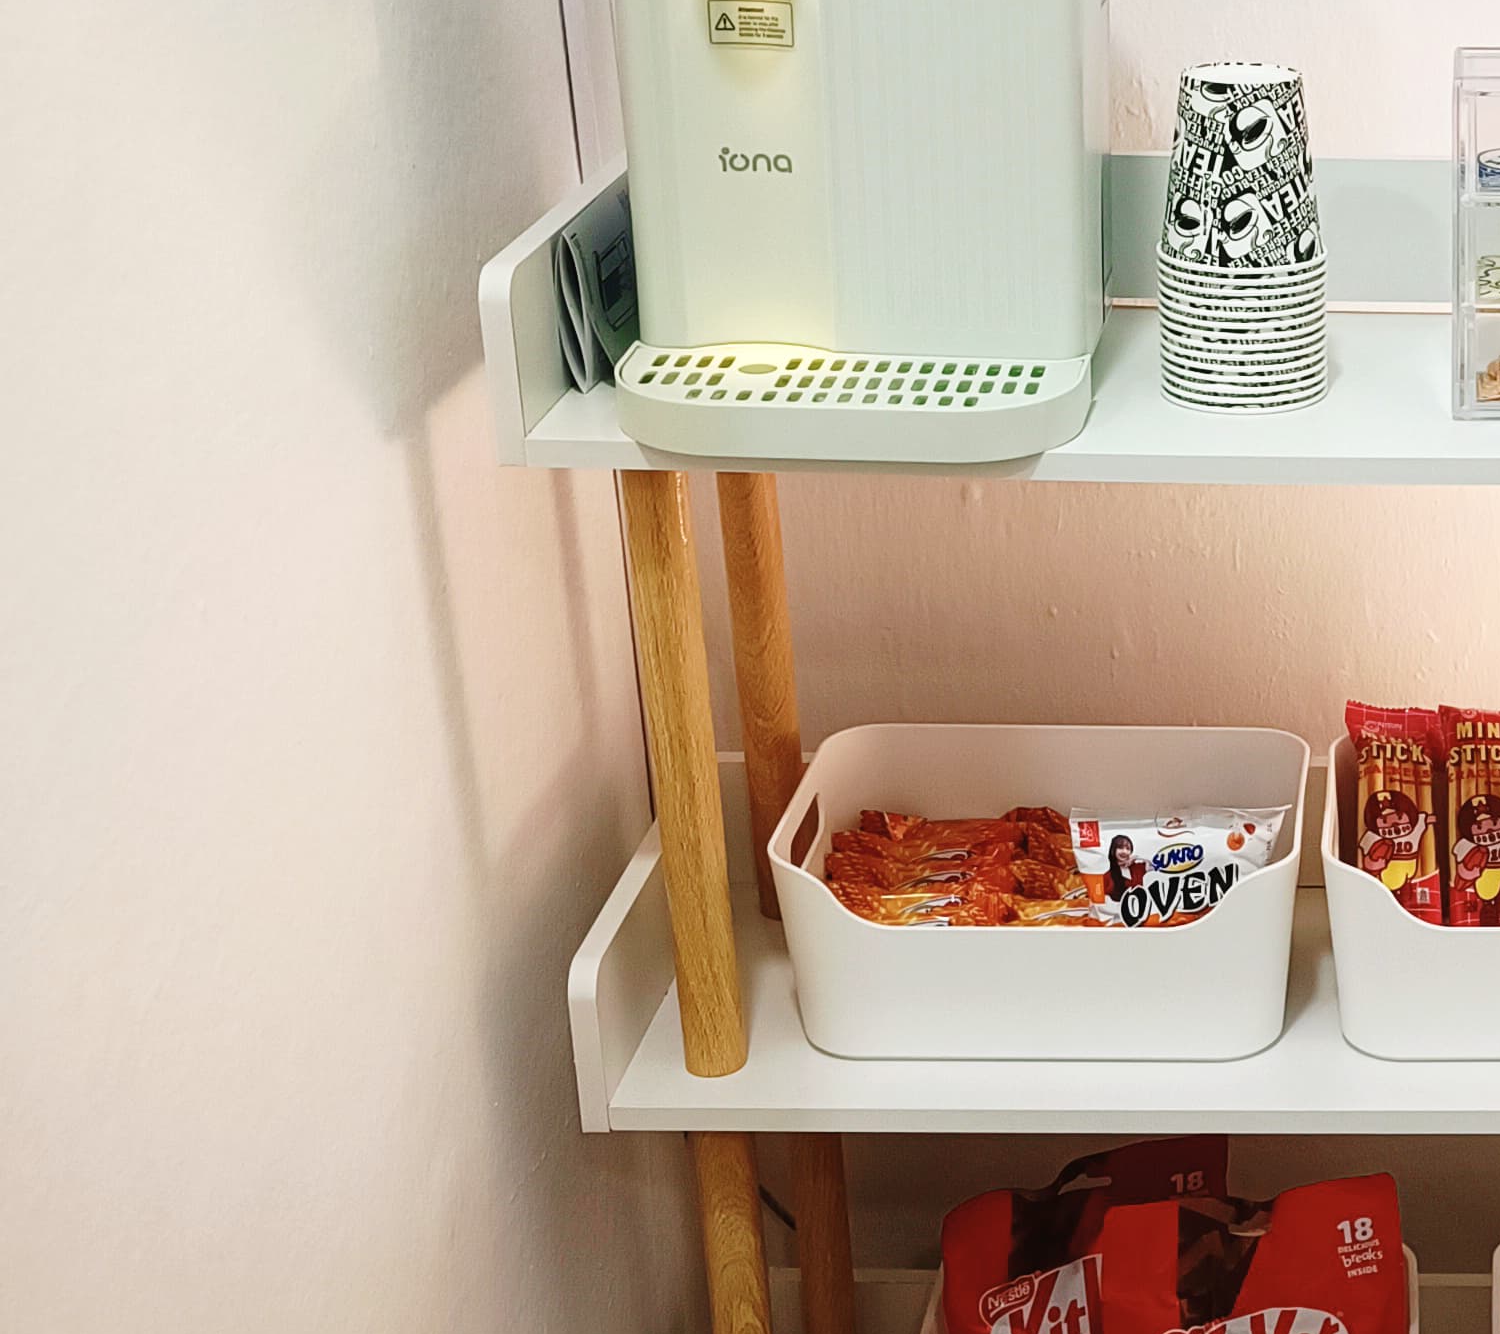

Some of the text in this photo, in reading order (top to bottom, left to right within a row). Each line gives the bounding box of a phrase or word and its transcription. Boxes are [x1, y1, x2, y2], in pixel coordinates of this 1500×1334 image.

[718, 147, 793, 173] iona
[1183, 140, 1226, 189] TEA
[1251, 173, 1274, 192] TEA
[1260, 176, 1310, 221] TEA
[1357, 740, 1426, 765] STICK
[1151, 844, 1204, 872] SUKRO
[1395, 840, 1413, 853] 10
[1121, 863, 1239, 927] OVEN
[1170, 1170, 1205, 1194] 18
[1337, 1217, 1374, 1244] 18
[1341, 1247, 1384, 1268] breaks
[1347, 1264, 1379, 1279] INSIDE
